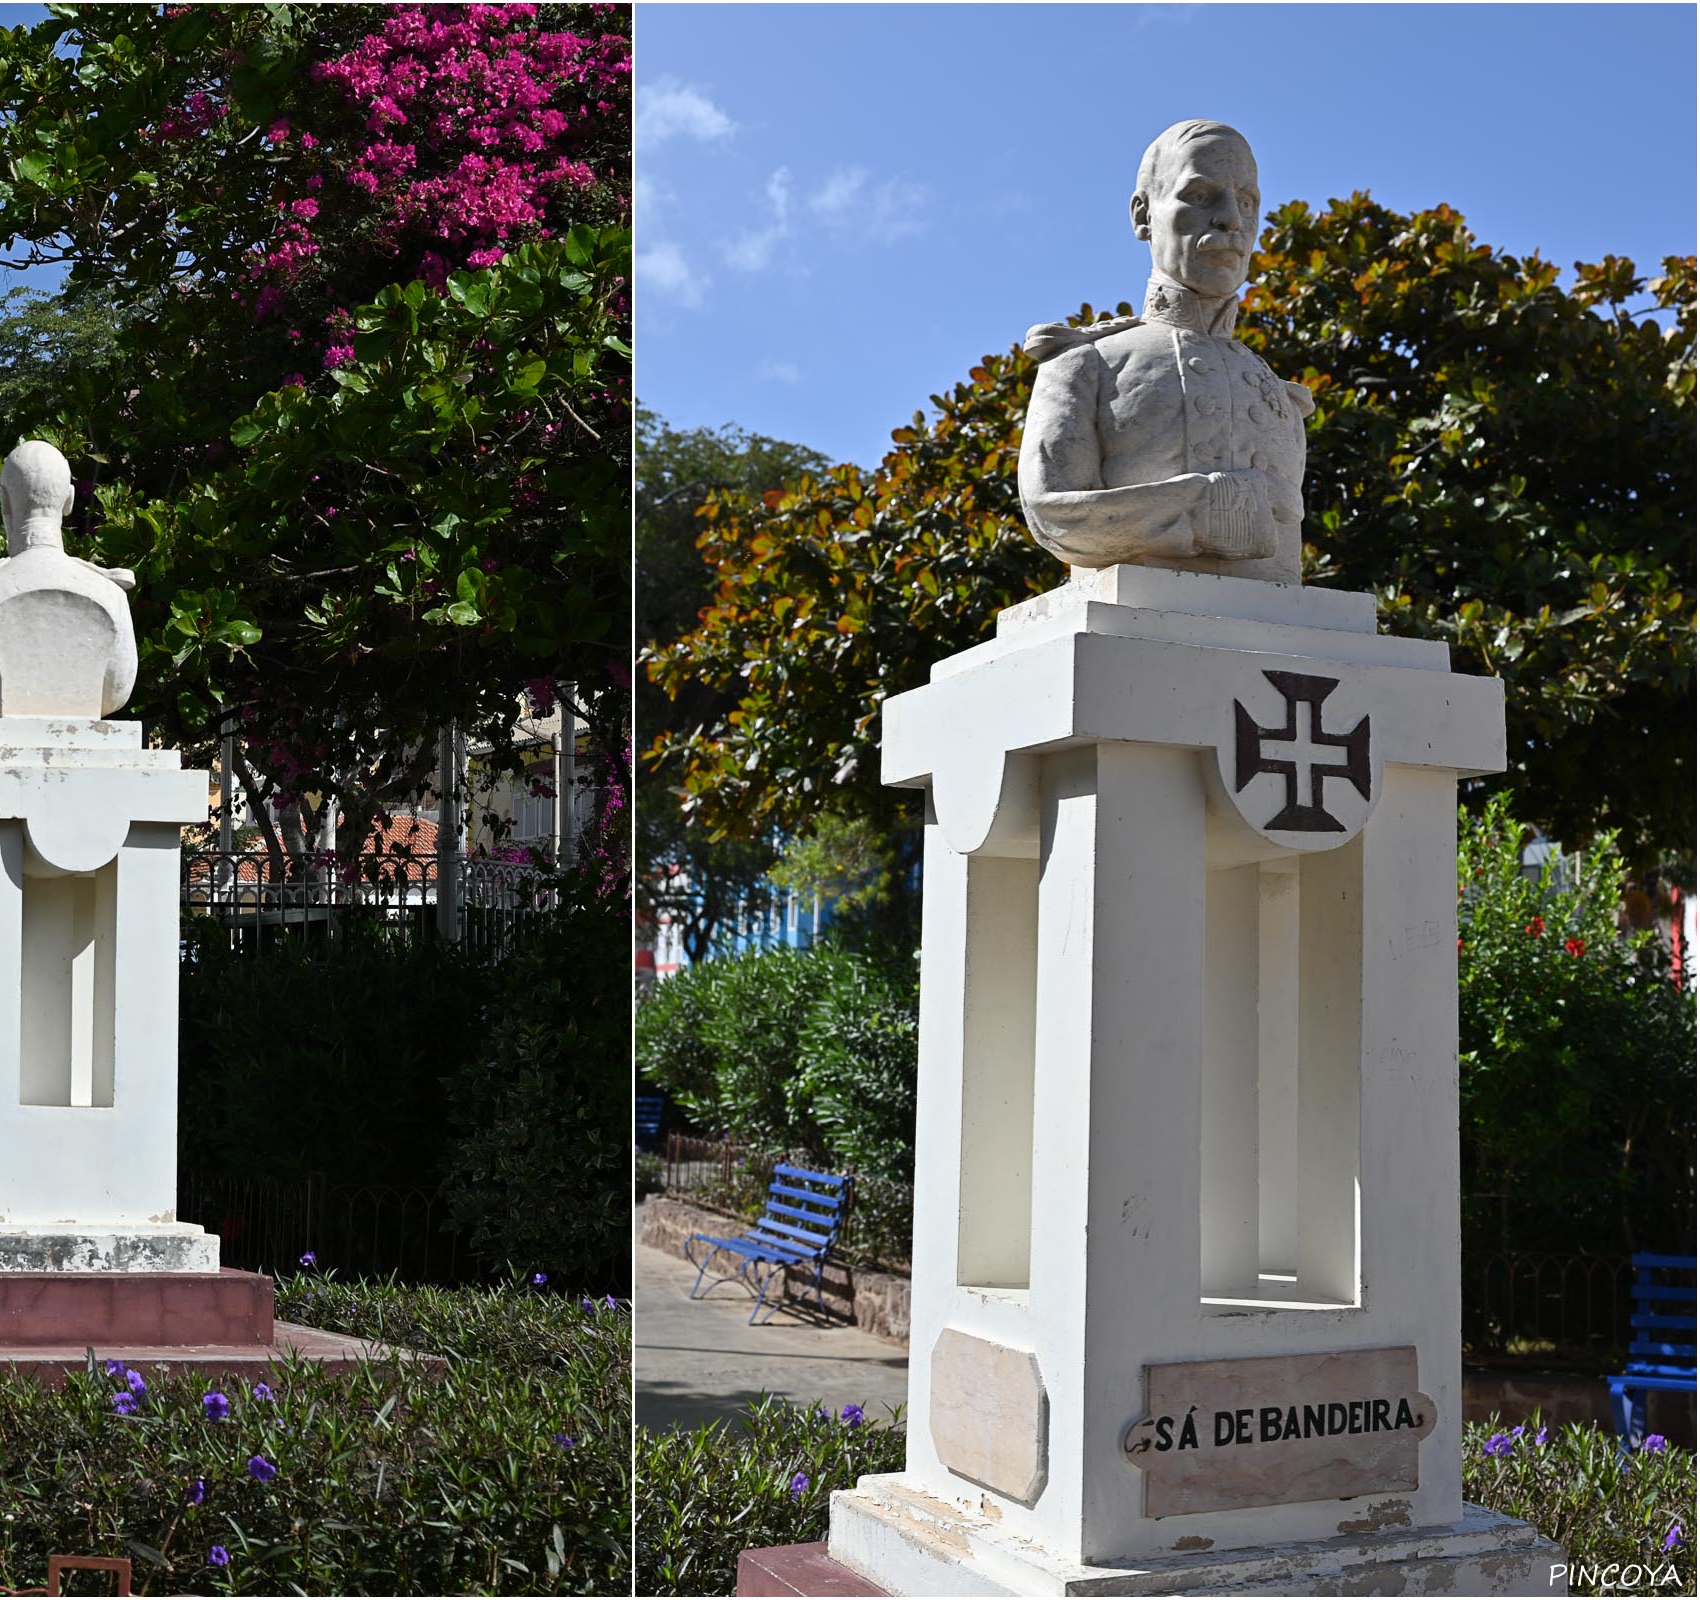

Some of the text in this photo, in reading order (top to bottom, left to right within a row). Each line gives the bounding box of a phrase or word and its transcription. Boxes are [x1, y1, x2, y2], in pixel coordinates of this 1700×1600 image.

[1154, 1398, 1416, 1451] SÁ DE BANDEIRA
